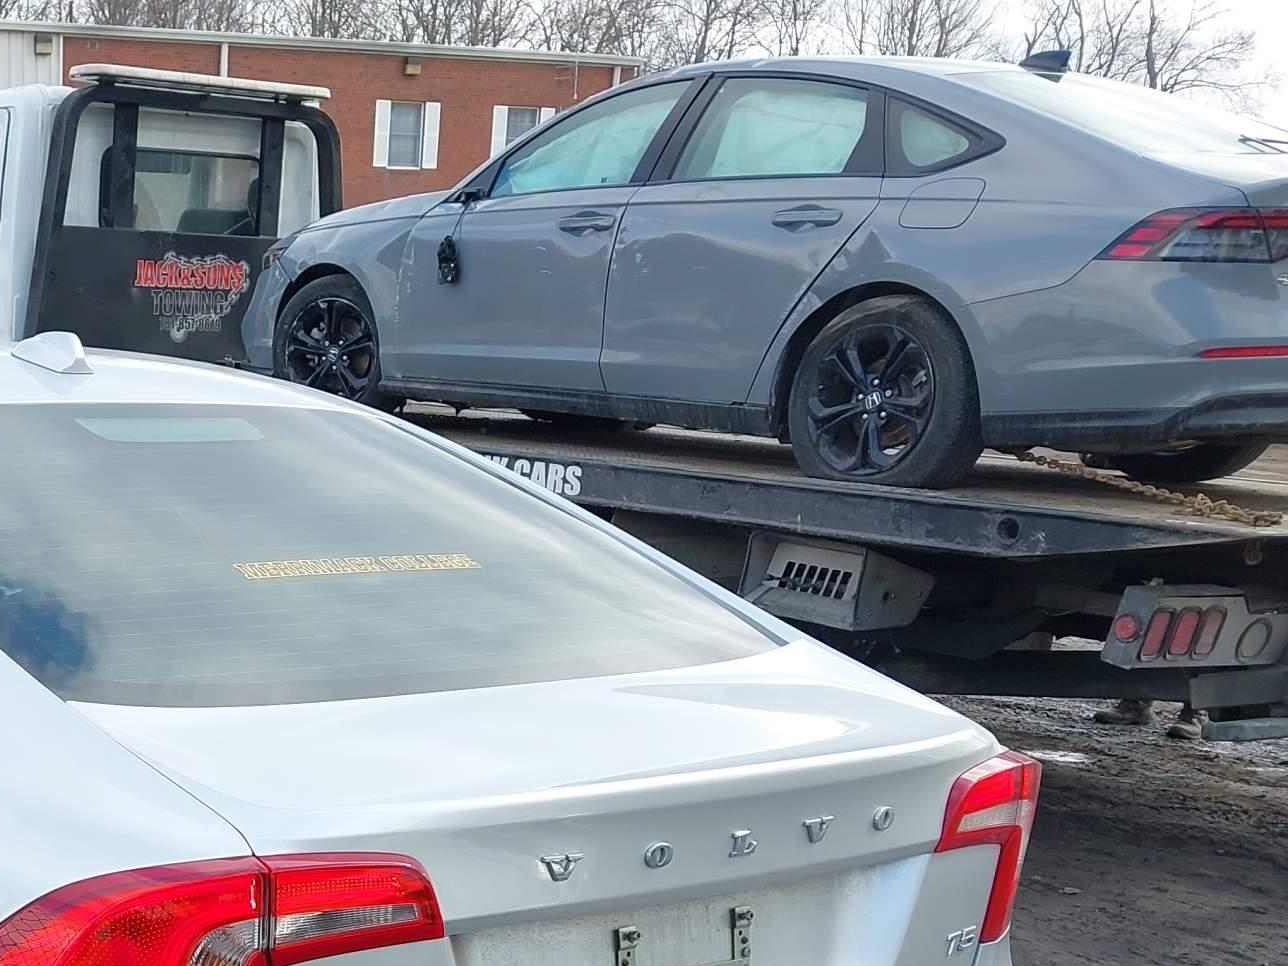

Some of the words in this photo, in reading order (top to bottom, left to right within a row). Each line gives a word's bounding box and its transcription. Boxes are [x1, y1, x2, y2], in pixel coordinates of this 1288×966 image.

[152, 289, 227, 316] TOWING
[513, 458, 583, 496] CARS
[378, 553, 482, 571] COLLEGE
[541, 805, 895, 882] VOLVO
[947, 925, 977, 956] T5
